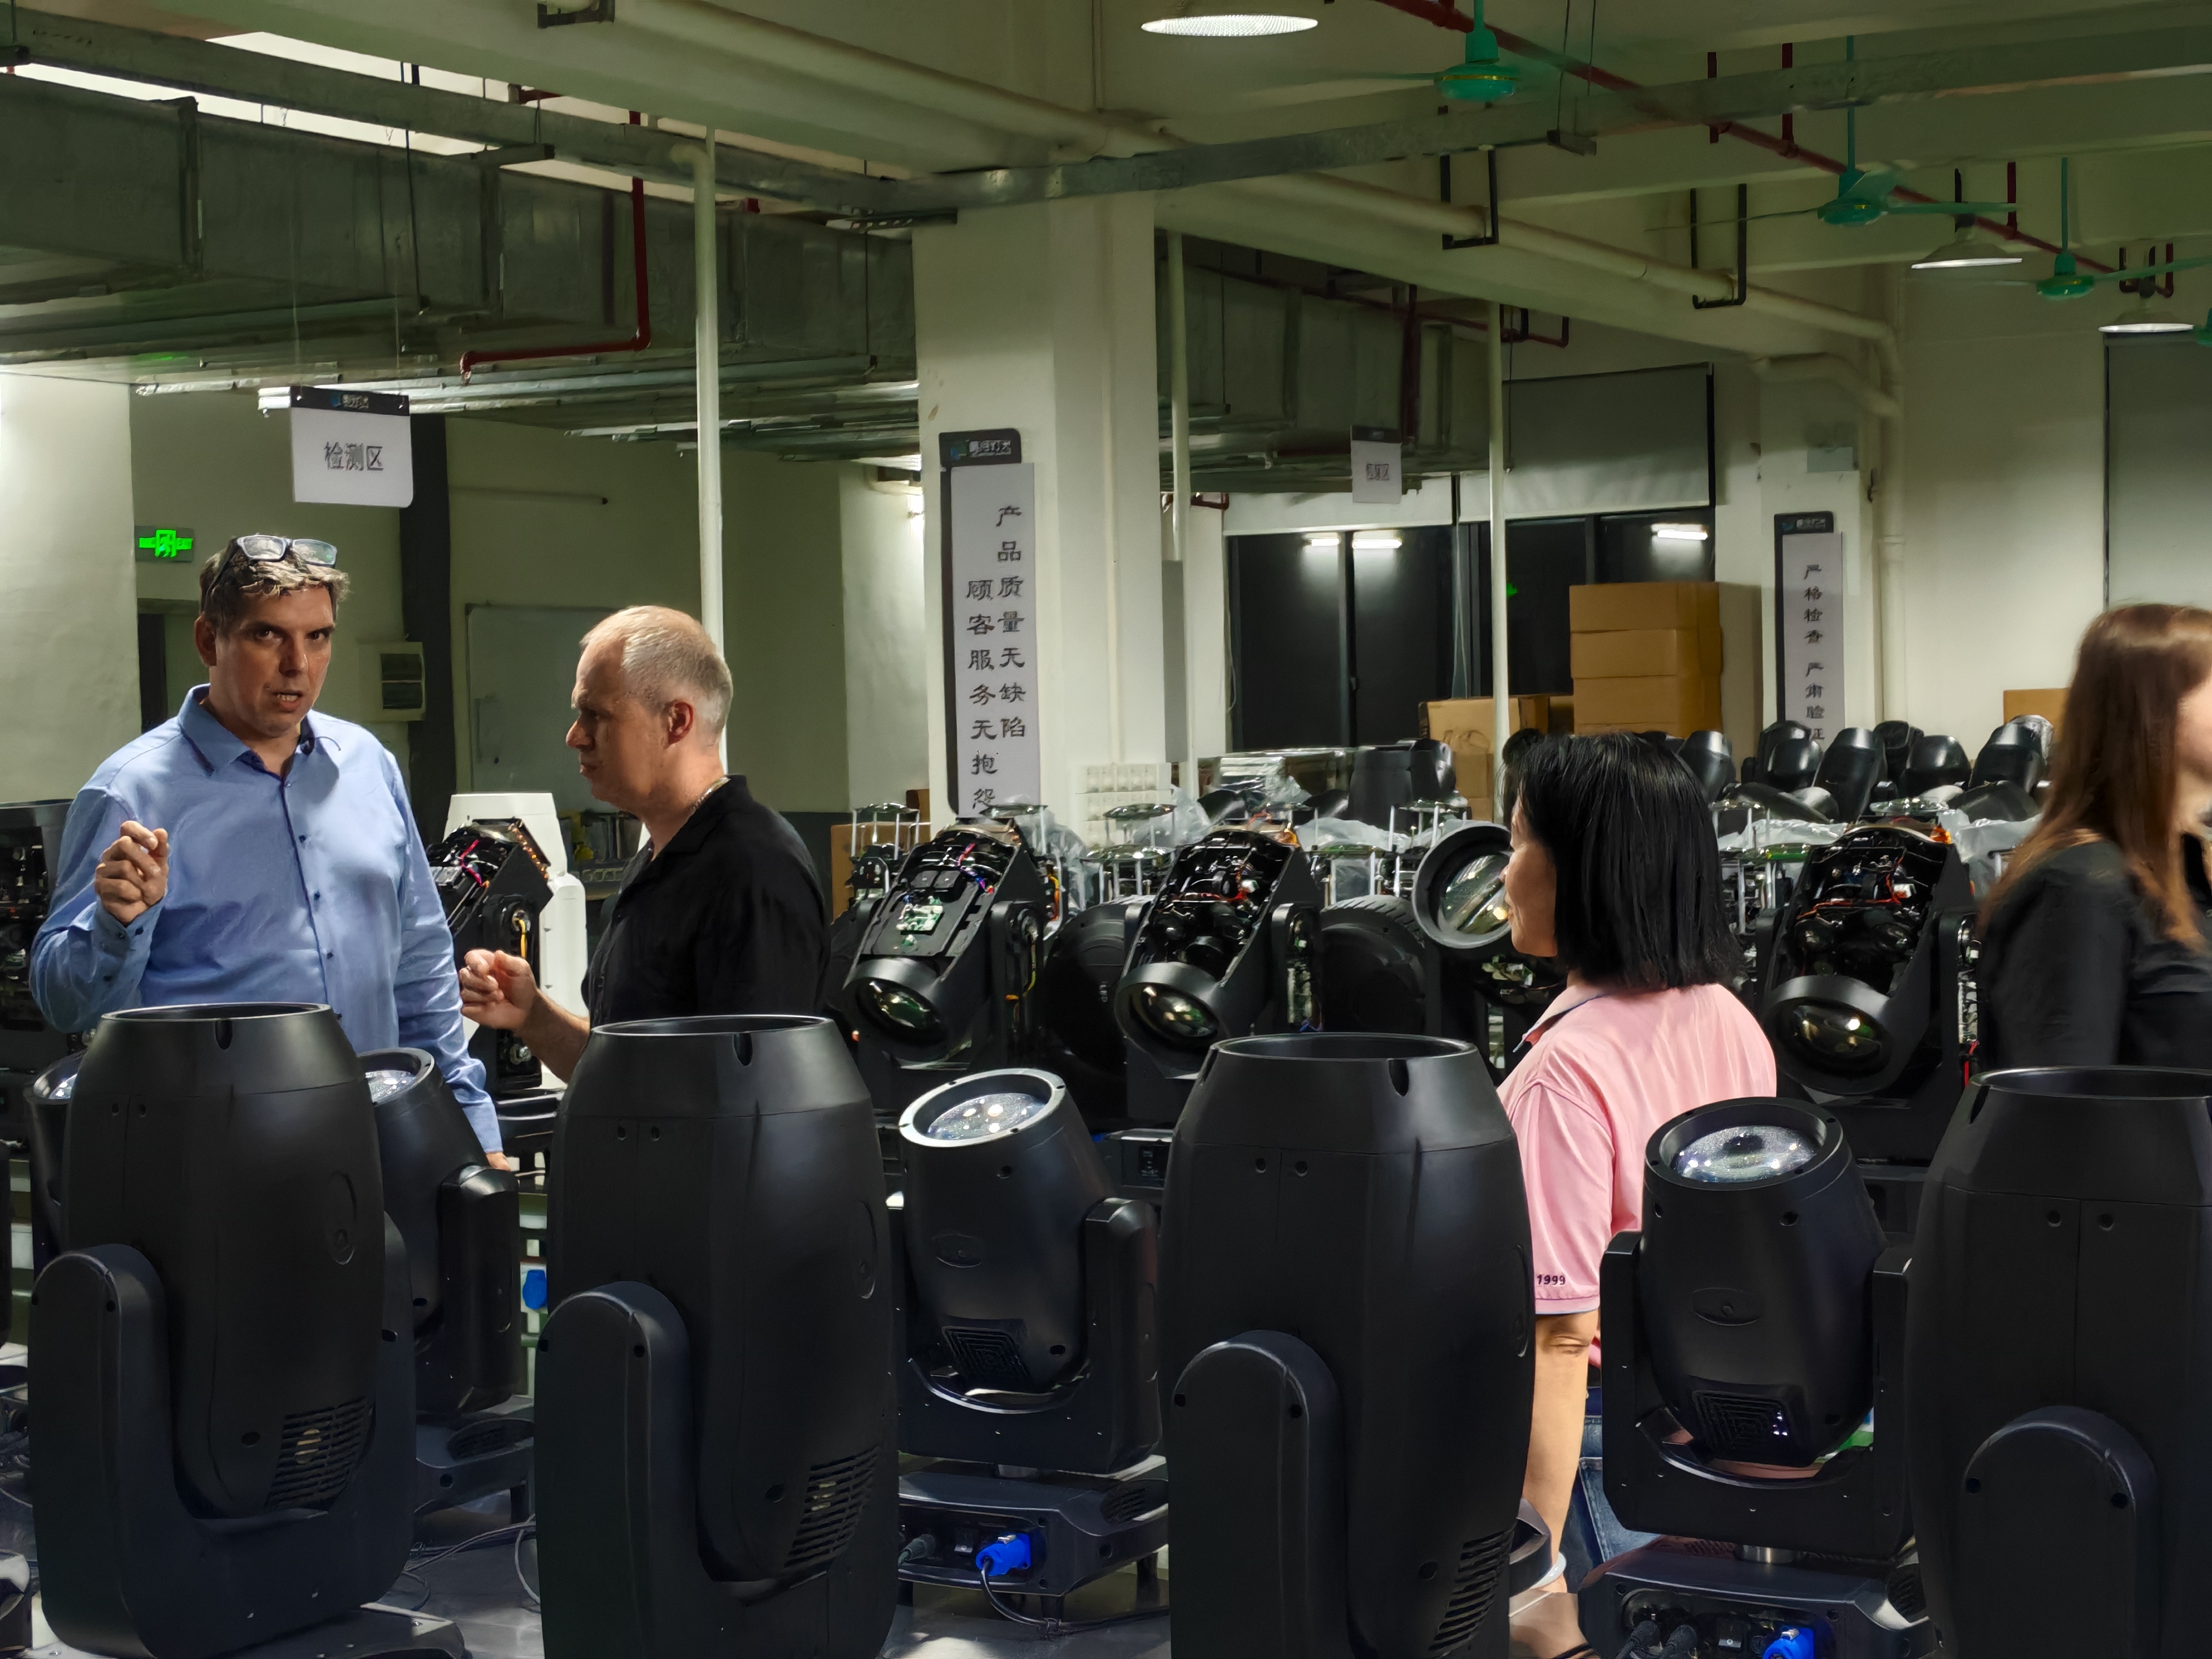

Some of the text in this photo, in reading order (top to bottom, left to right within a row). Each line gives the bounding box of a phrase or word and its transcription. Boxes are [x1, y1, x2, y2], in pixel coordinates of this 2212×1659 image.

[324, 441, 384, 471] 检测区
[996, 505, 1026, 738] 产品质量无缺陷
[966, 579, 998, 810] 顾客服务无抱怨
[1536, 1274, 1566, 1285] 1999
